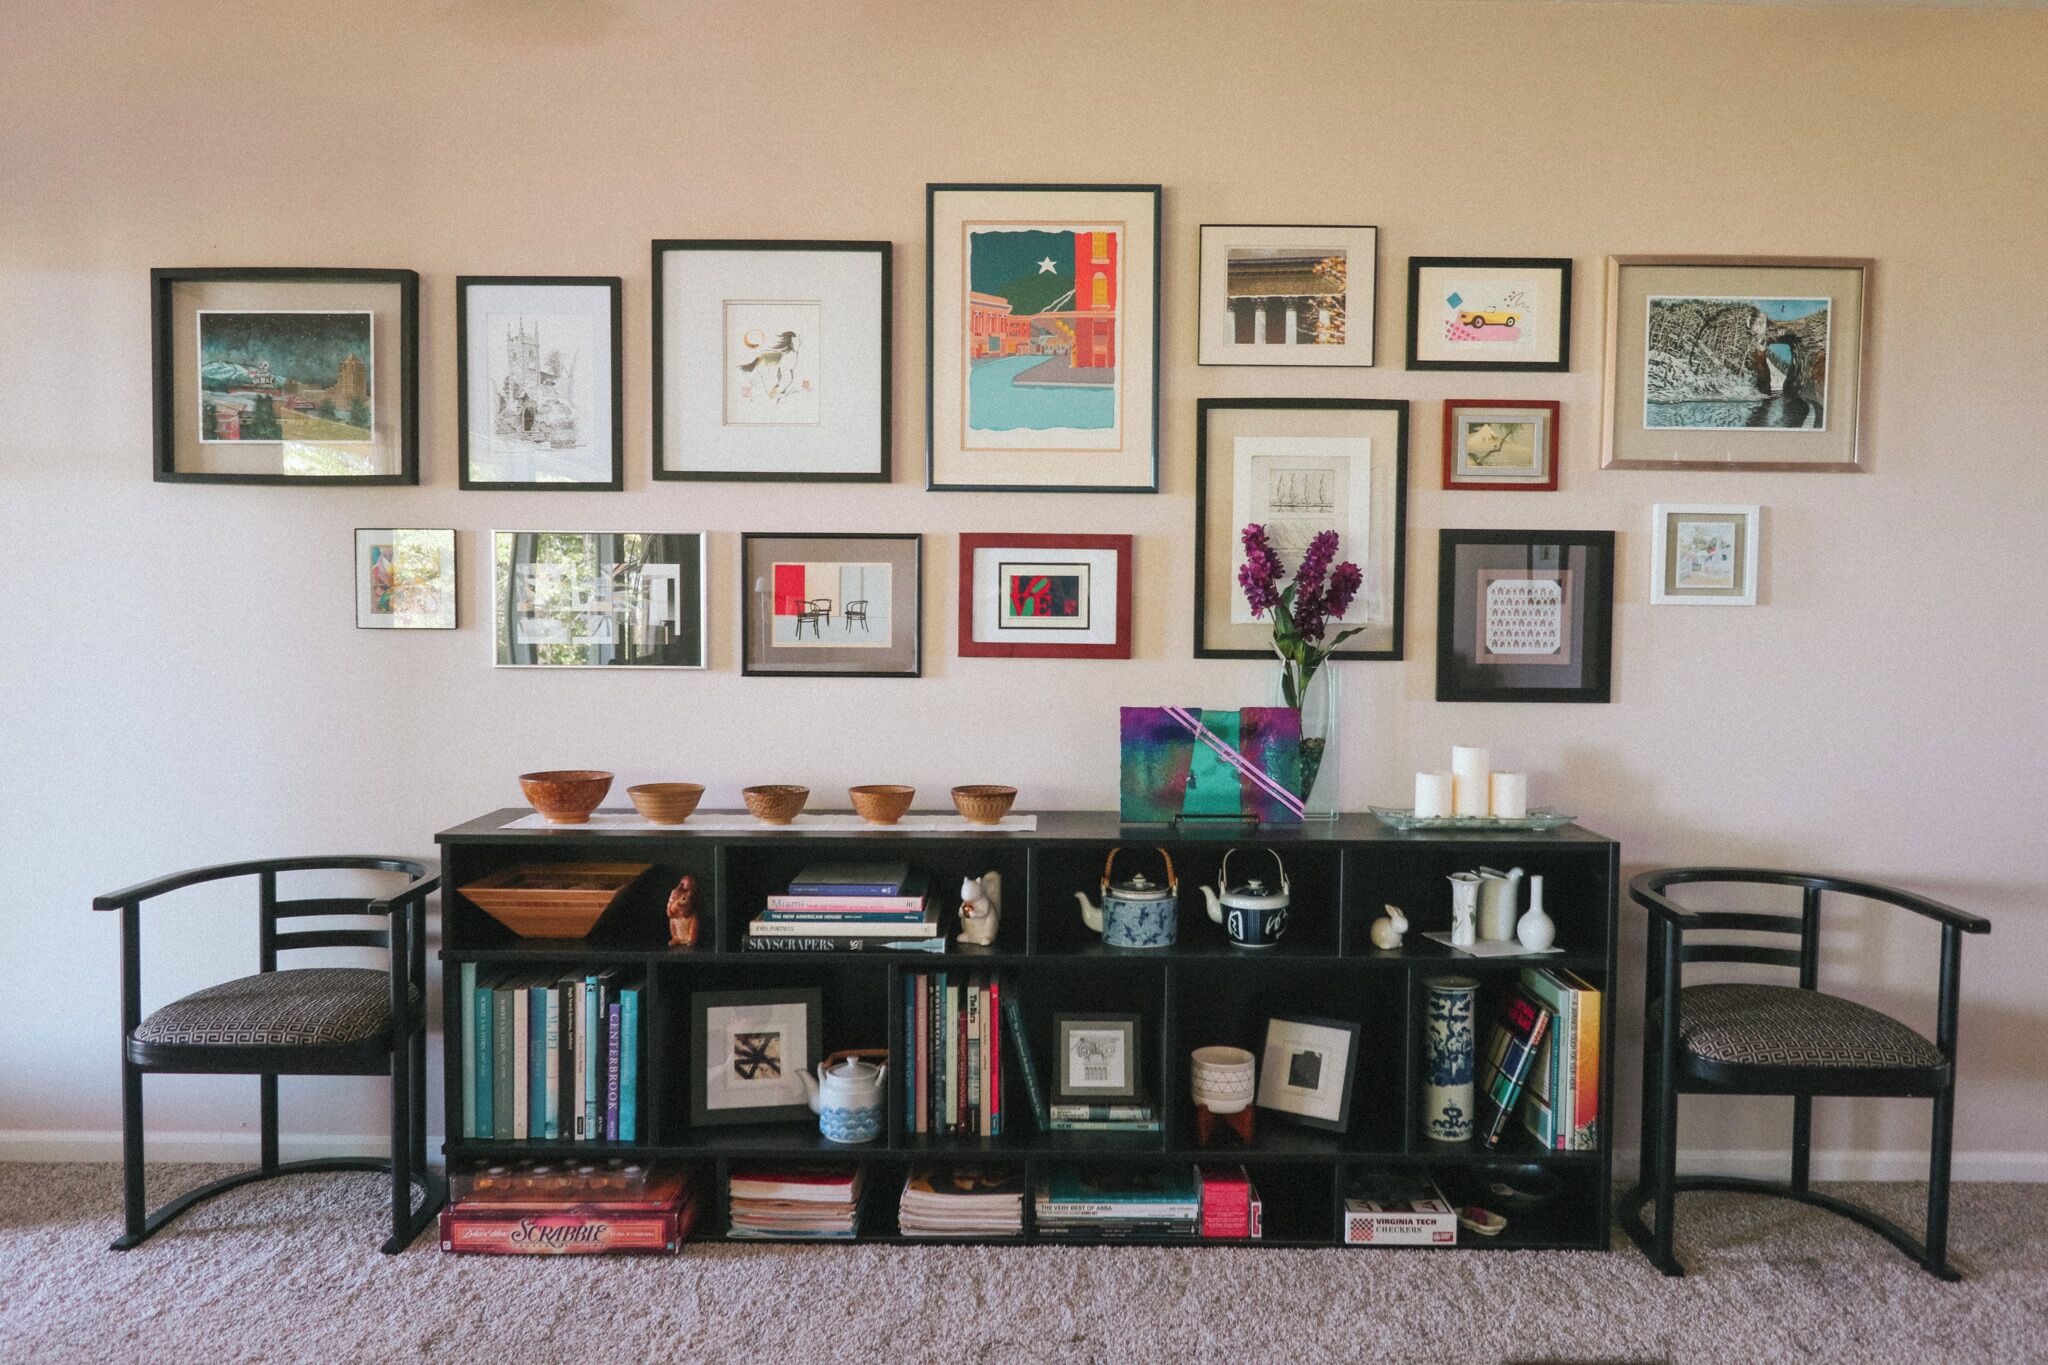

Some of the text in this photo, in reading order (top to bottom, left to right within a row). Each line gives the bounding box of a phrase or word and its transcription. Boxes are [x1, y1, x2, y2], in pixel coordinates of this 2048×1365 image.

[749, 938, 834, 951] SKYSCRAPERS
[970, 995, 978, 1024] The Barn
[608, 1013, 619, 1110] CENTERBROOK
[511, 1218, 608, 1248] SCRABBLE
